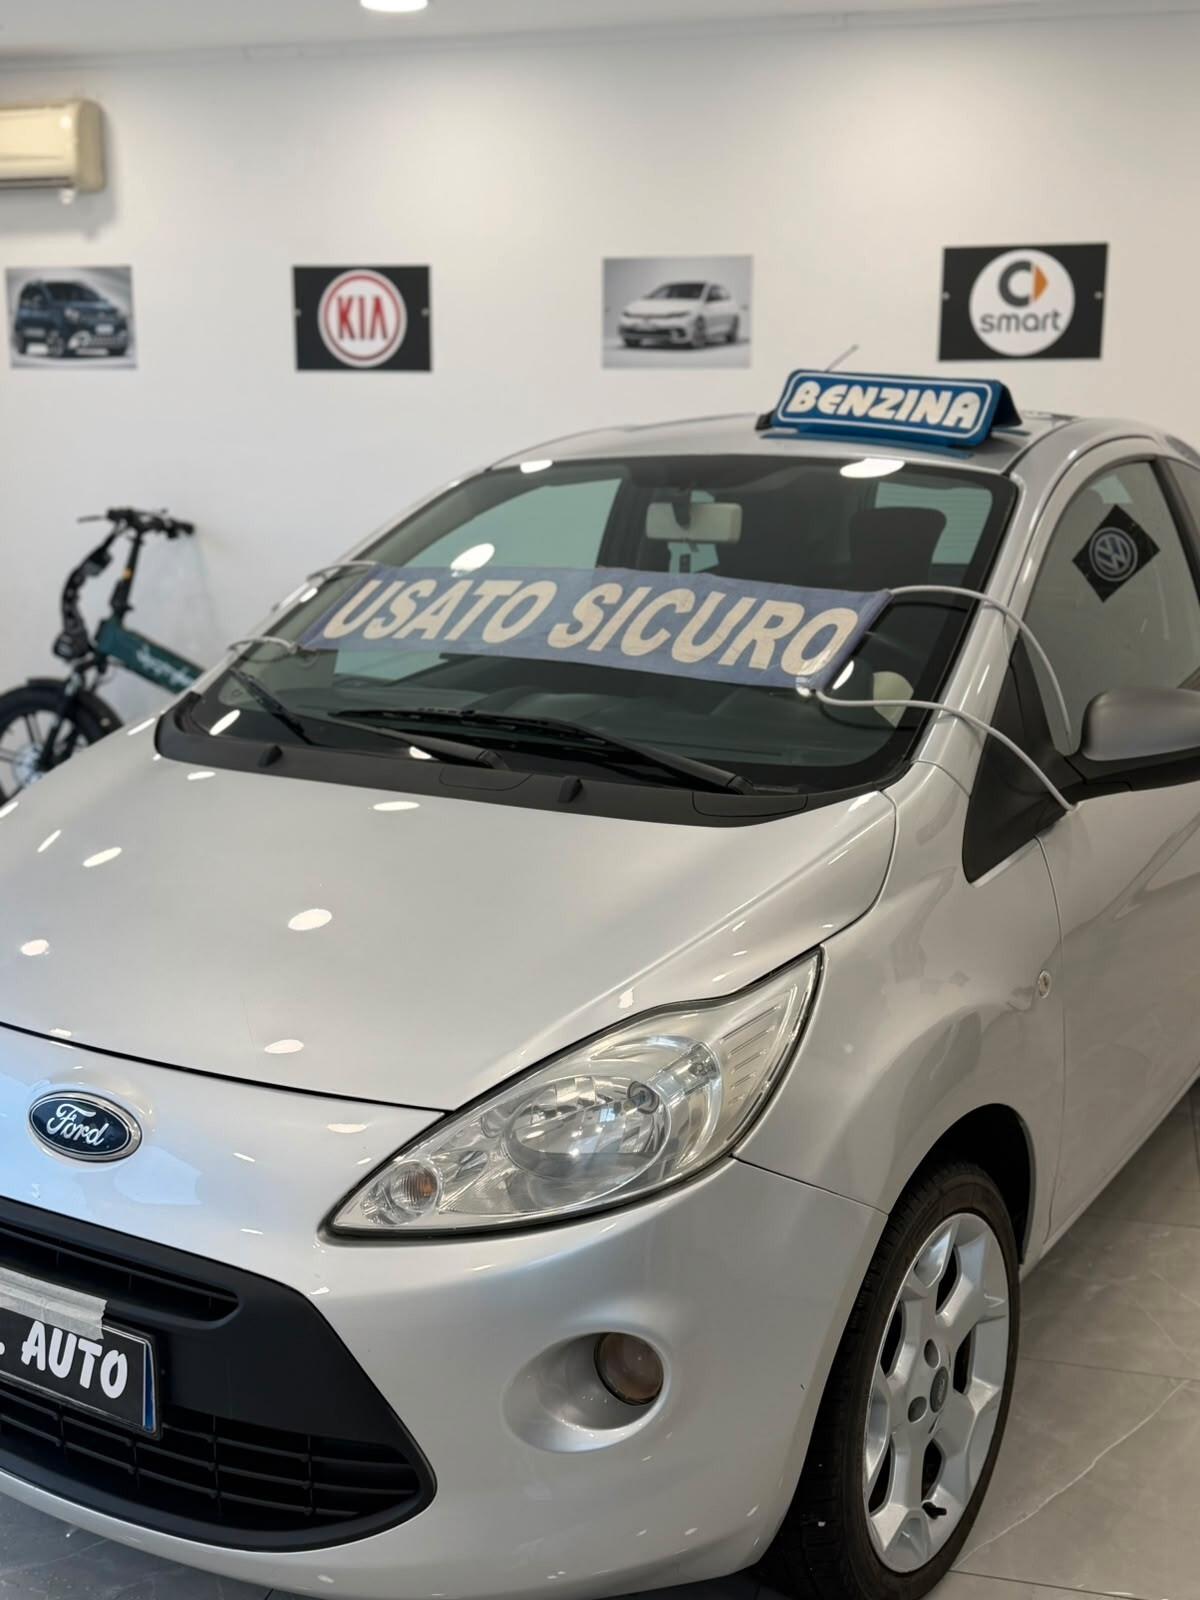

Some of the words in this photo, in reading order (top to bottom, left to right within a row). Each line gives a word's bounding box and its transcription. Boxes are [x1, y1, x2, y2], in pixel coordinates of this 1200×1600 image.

[337, 295, 388, 340] KIA
[979, 309, 1061, 334] smart
[785, 380, 981, 430] BENZINA
[323, 578, 558, 644] USATO
[547, 582, 859, 676] SICURO
[46, 1103, 110, 1146] Ford
[21, 1320, 128, 1399] AUTO
